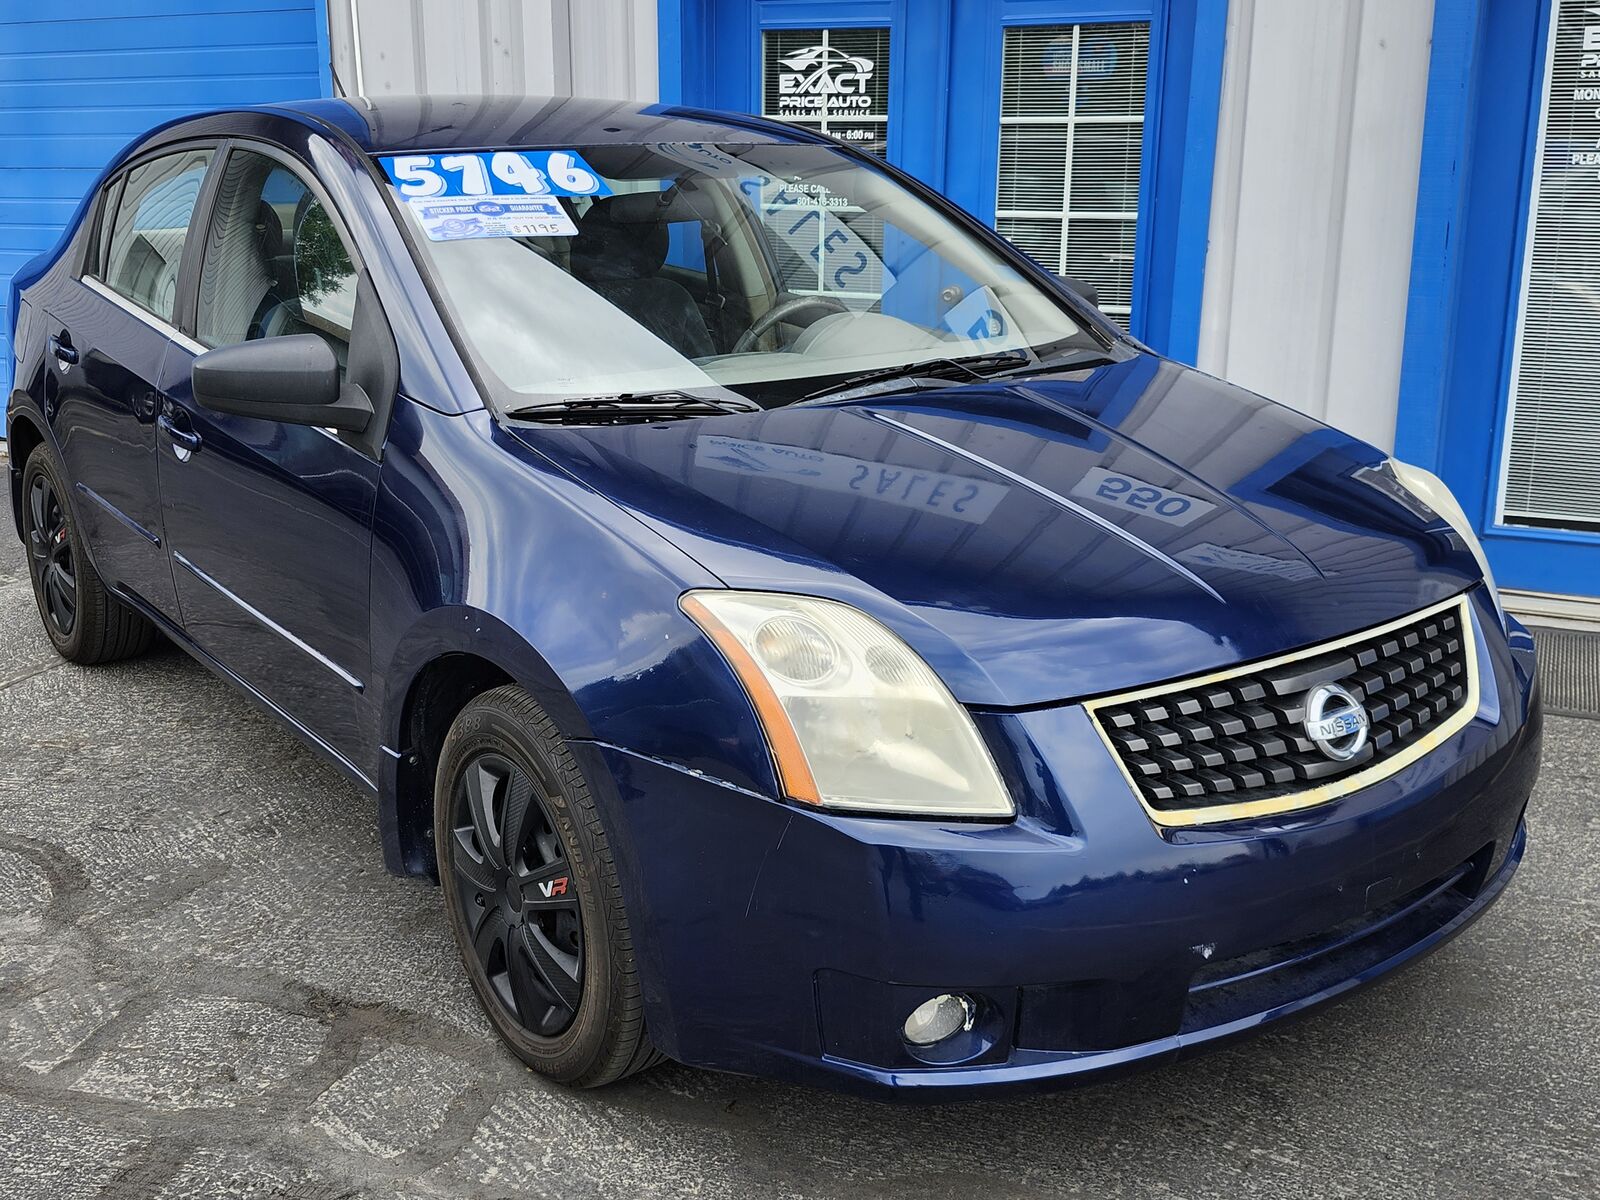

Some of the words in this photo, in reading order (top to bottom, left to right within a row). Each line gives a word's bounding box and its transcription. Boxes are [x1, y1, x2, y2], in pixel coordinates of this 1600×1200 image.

[779, 73, 873, 94] EXACT
[779, 96, 824, 108] PRICE
[827, 96, 872, 108] AUTO
[779, 109, 806, 117] SALES
[832, 109, 871, 117] SERVICE
[846, 129, 864, 139] 6:00
[864, 131, 874, 140] PM
[393, 151, 600, 197] 5746
[779, 184, 809, 194] PLEASE
[810, 184, 831, 194] CALL
[429, 206, 455, 214] STICKER
[509, 204, 545, 212] GUARANTEE
[1320, 713, 1366, 736] NISSAN
[538, 876, 569, 898] VR
